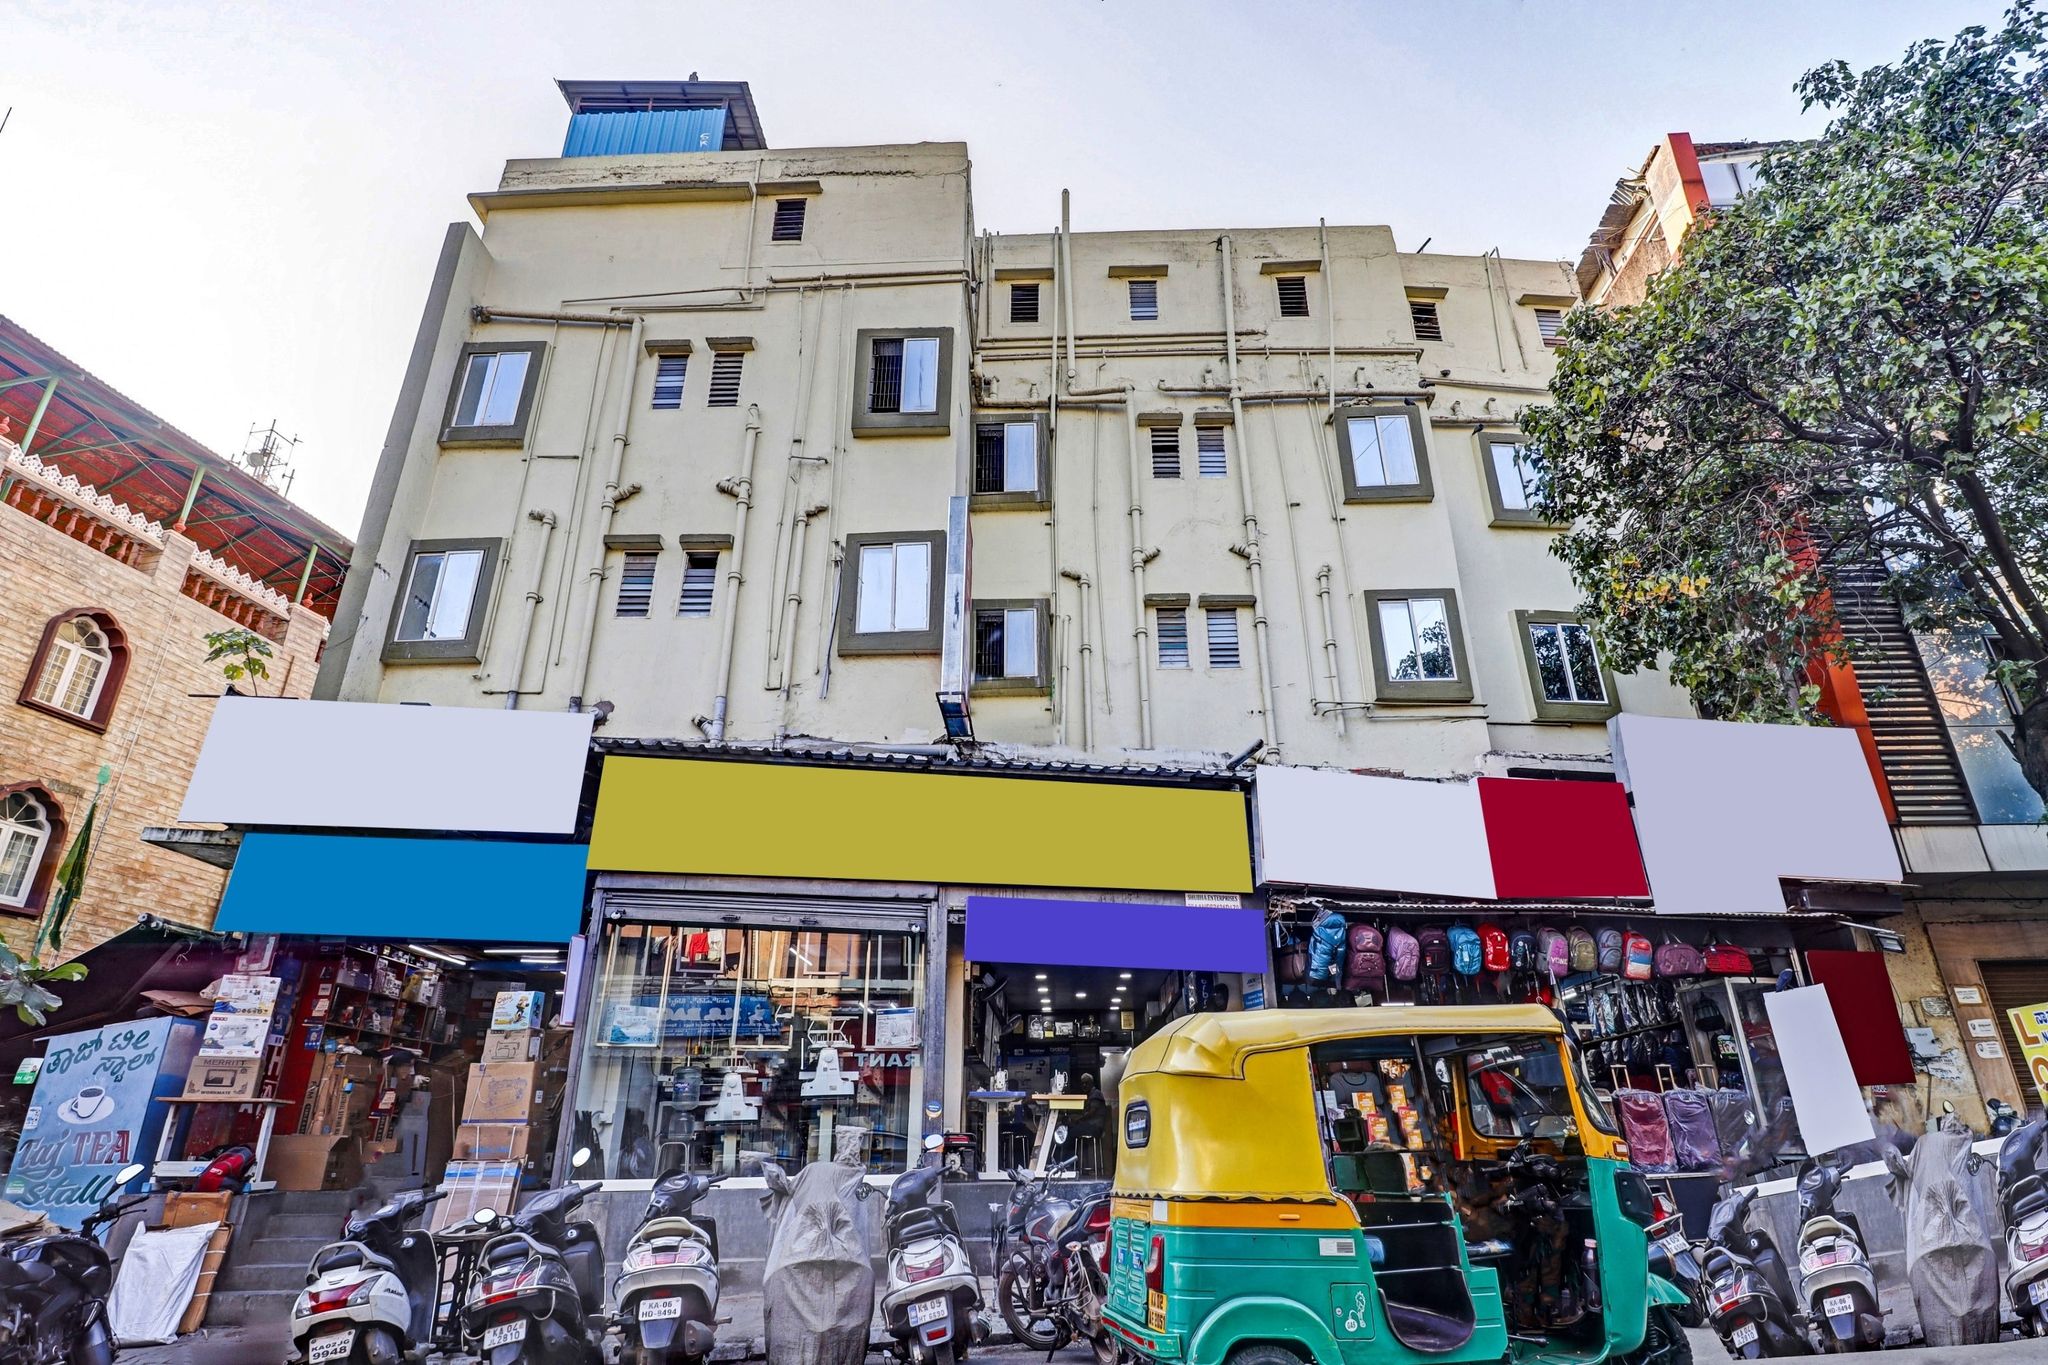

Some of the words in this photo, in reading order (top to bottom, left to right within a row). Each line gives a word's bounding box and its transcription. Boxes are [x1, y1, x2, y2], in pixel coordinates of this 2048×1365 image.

[203, 1058, 249, 1067] MERRITT
[17, 1129, 72, 1182] Taj
[71, 1130, 133, 1168] TEA
[310, 1338, 350, 1352] KA02JG
[312, 1345, 347, 1361] 9948
